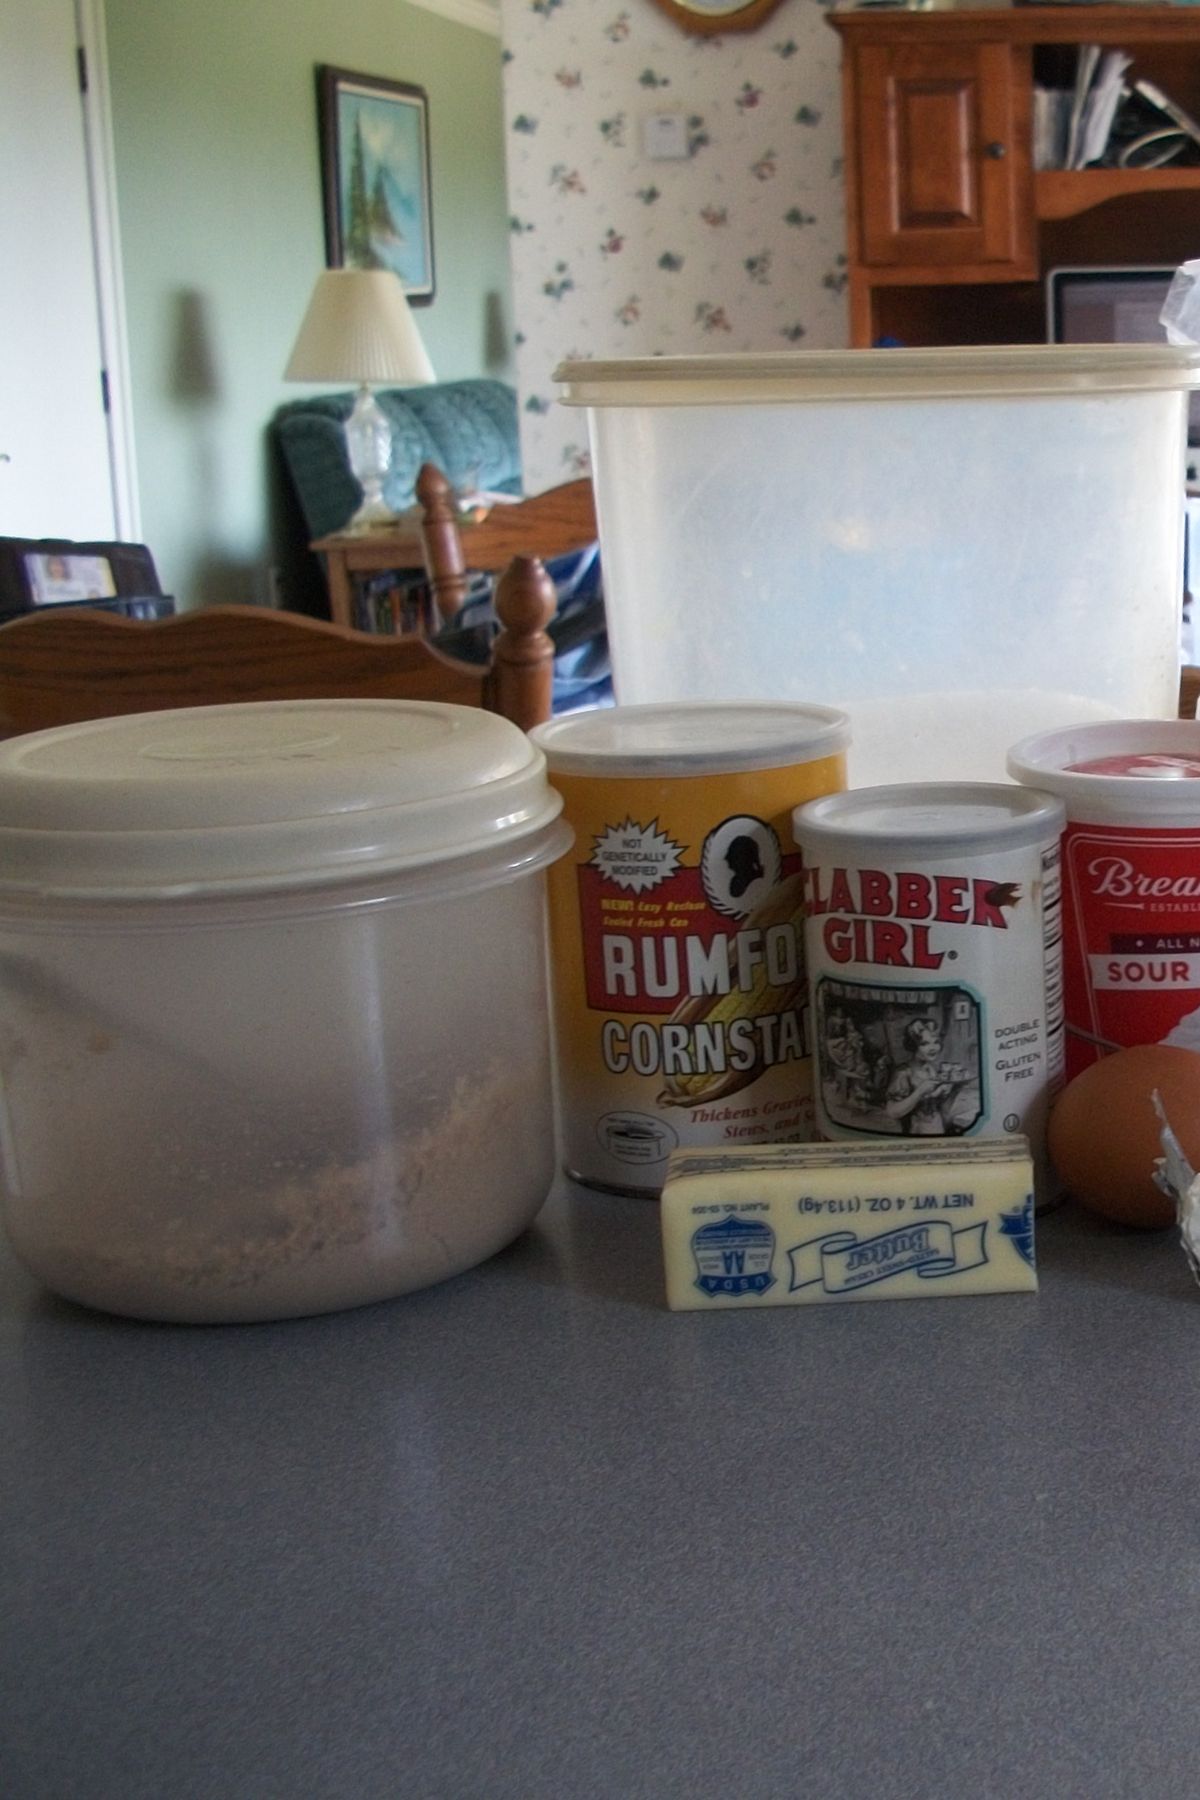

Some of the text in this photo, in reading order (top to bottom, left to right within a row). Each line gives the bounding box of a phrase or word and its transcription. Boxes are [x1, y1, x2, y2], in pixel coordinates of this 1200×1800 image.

[621, 838, 642, 849] NOT
[602, 851, 667, 863] GENETICALLY
[611, 865, 657, 876] MODIFIED
[824, 917, 946, 970] GIRL
[1155, 937, 1184, 949] ALL
[1107, 960, 1190, 983] SOUR
[995, 1018, 1040, 1039] DOUBLE
[998, 1033, 1038, 1052] ACTING
[995, 1052, 1041, 1071] GLUTEN
[1004, 1066, 1034, 1083] FREE
[691, 1107, 760, 1123] Thickens
[775, 1114, 800, 1131] and
[798, 1196, 861, 1214] (113.4g)
[896, 1197, 906, 1210] 4
[910, 1196, 937, 1210] WT.
[943, 1192, 974, 1208] NET
[845, 1228, 929, 1270] Butter
[722, 1250, 745, 1274] AA
